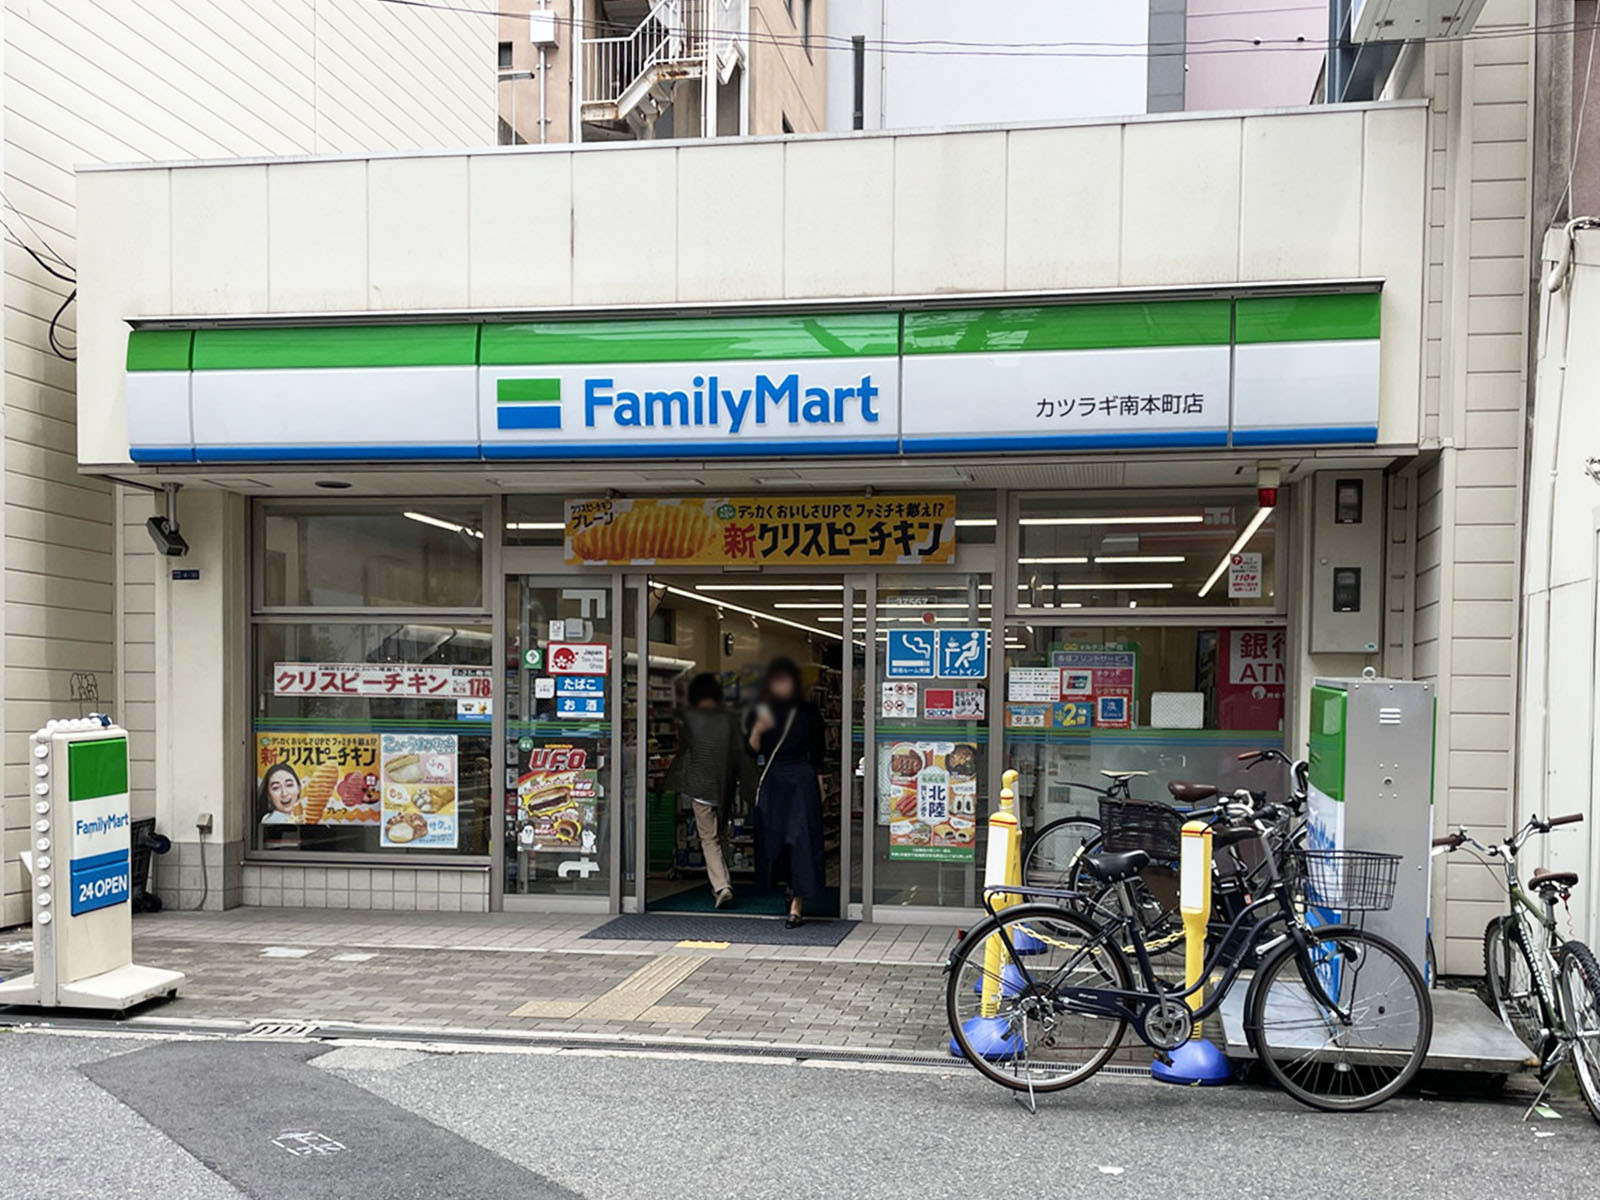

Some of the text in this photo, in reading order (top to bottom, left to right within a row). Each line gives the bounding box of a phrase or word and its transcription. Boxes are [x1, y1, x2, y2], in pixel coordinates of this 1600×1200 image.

[584, 374, 880, 433] FamilyMart
[1036, 393, 1204, 418] カツラギ南本町店
[572, 512, 614, 529] プレーン
[723, 520, 943, 559] 新クリスピーチキン
[276, 671, 448, 693] クリスピーチキン
[563, 678, 597, 690] たばこ
[260, 746, 377, 767] 新クリスピーチキン
[929, 785, 946, 818] 北陸
[76, 813, 129, 836] FamilyMart
